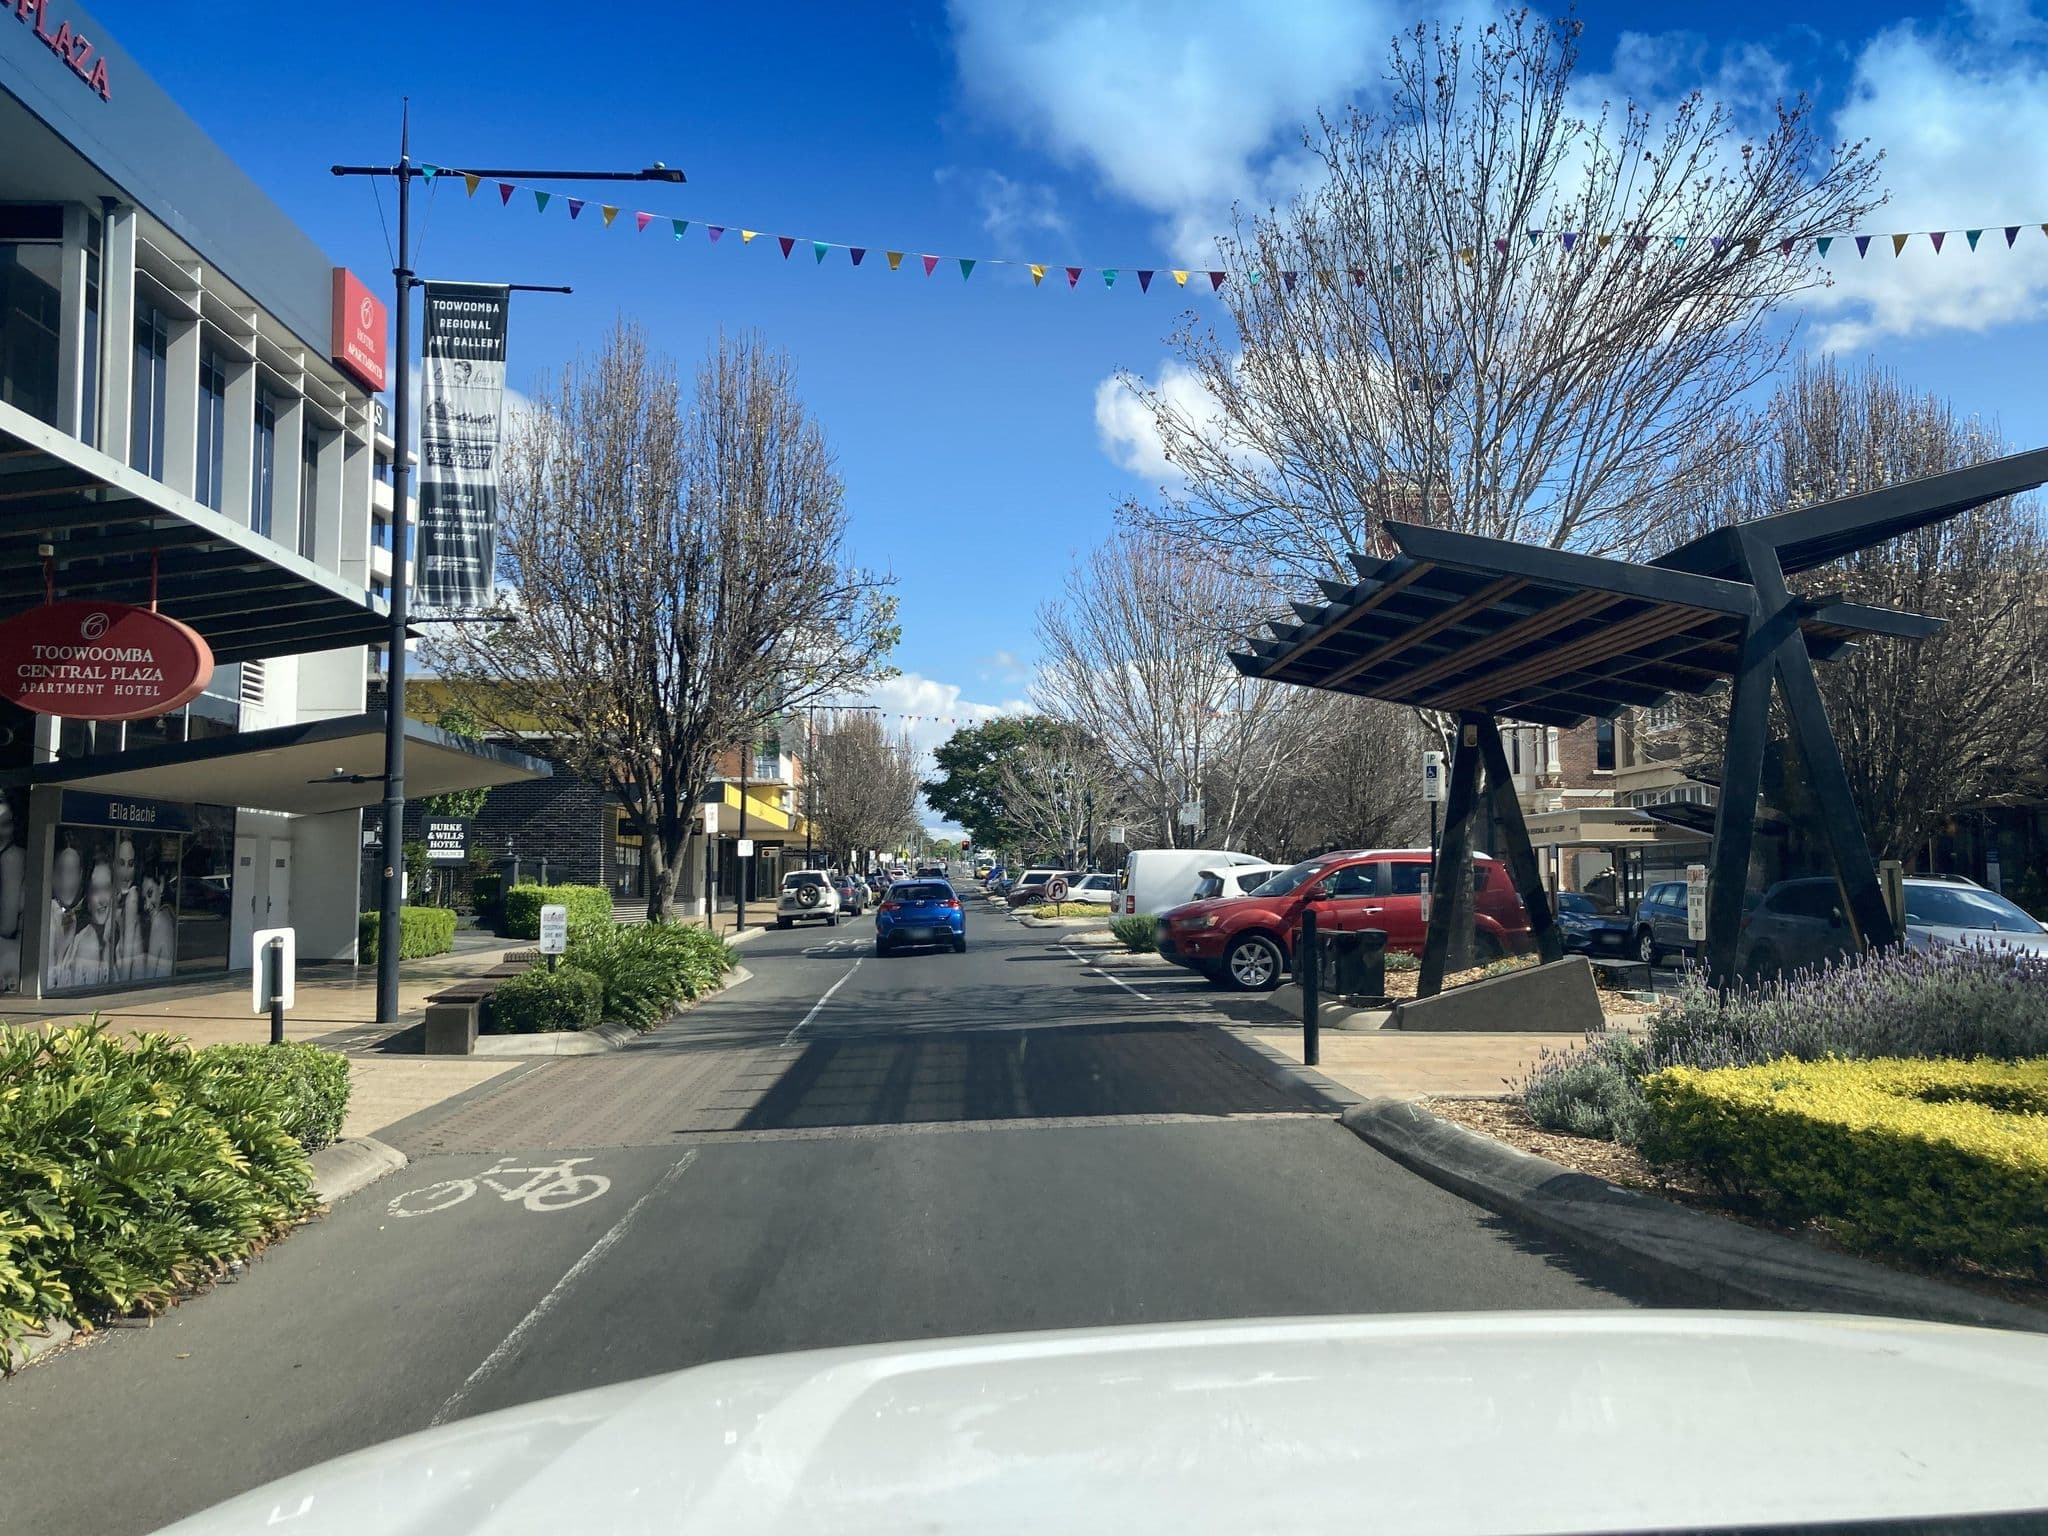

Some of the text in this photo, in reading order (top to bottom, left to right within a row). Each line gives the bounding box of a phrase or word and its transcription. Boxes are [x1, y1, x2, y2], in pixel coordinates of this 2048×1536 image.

[432, 300, 500, 313] TOOWOOMBA
[439, 318, 492, 330] REGIONAL
[356, 328, 376, 353] HOTEL
[429, 335, 501, 349] ART GALLERY
[32, 645, 154, 663] TOOWOOMBA
[17, 664, 164, 682] CENTRAL PLAZA
[19, 682, 161, 696] APARTMENT HOTEL
[110, 802, 156, 823] Ella Baché
[430, 823, 463, 831] BURKE
[427, 832, 465, 840] & WILLS
[430, 840, 462, 849] HOTEL
